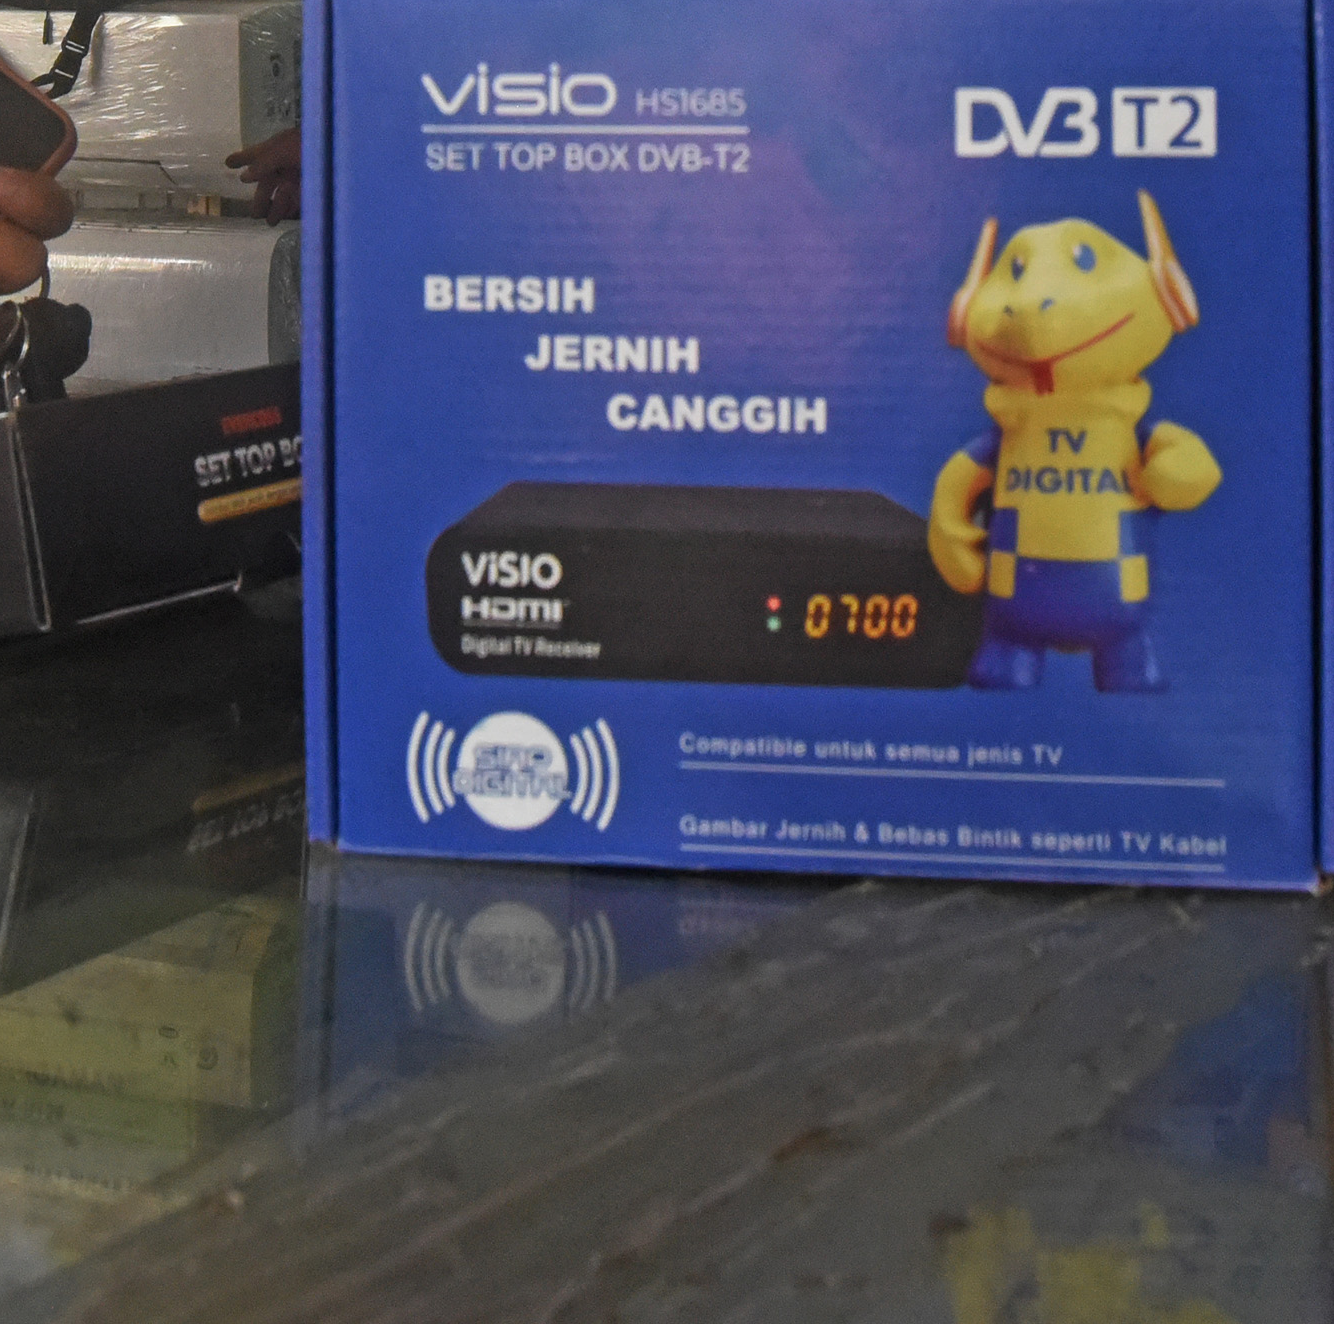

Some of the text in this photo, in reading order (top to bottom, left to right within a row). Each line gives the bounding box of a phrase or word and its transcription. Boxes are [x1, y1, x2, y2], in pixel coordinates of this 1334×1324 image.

[635, 88, 747, 116] HS1685
[955, 87, 1208, 158] DVB T2
[426, 142, 751, 173] SET TOP BOX DVB-T2
[424, 276, 596, 313] BERSIH
[525, 334, 700, 374] JERNIH
[607, 393, 827, 434] CANGGIH
[1048, 427, 1087, 454] TV
[194, 450, 231, 488] SET
[233, 441, 276, 478] TOP
[804, 593, 918, 639] 0700
[461, 633, 602, 659] Digital TV Receiver
[679, 731, 1064, 769] Compatible untuk semua jenis TV
[679, 813, 1227, 857] Gambar Jernih & Bebas Bintik seperti TV Kabel
